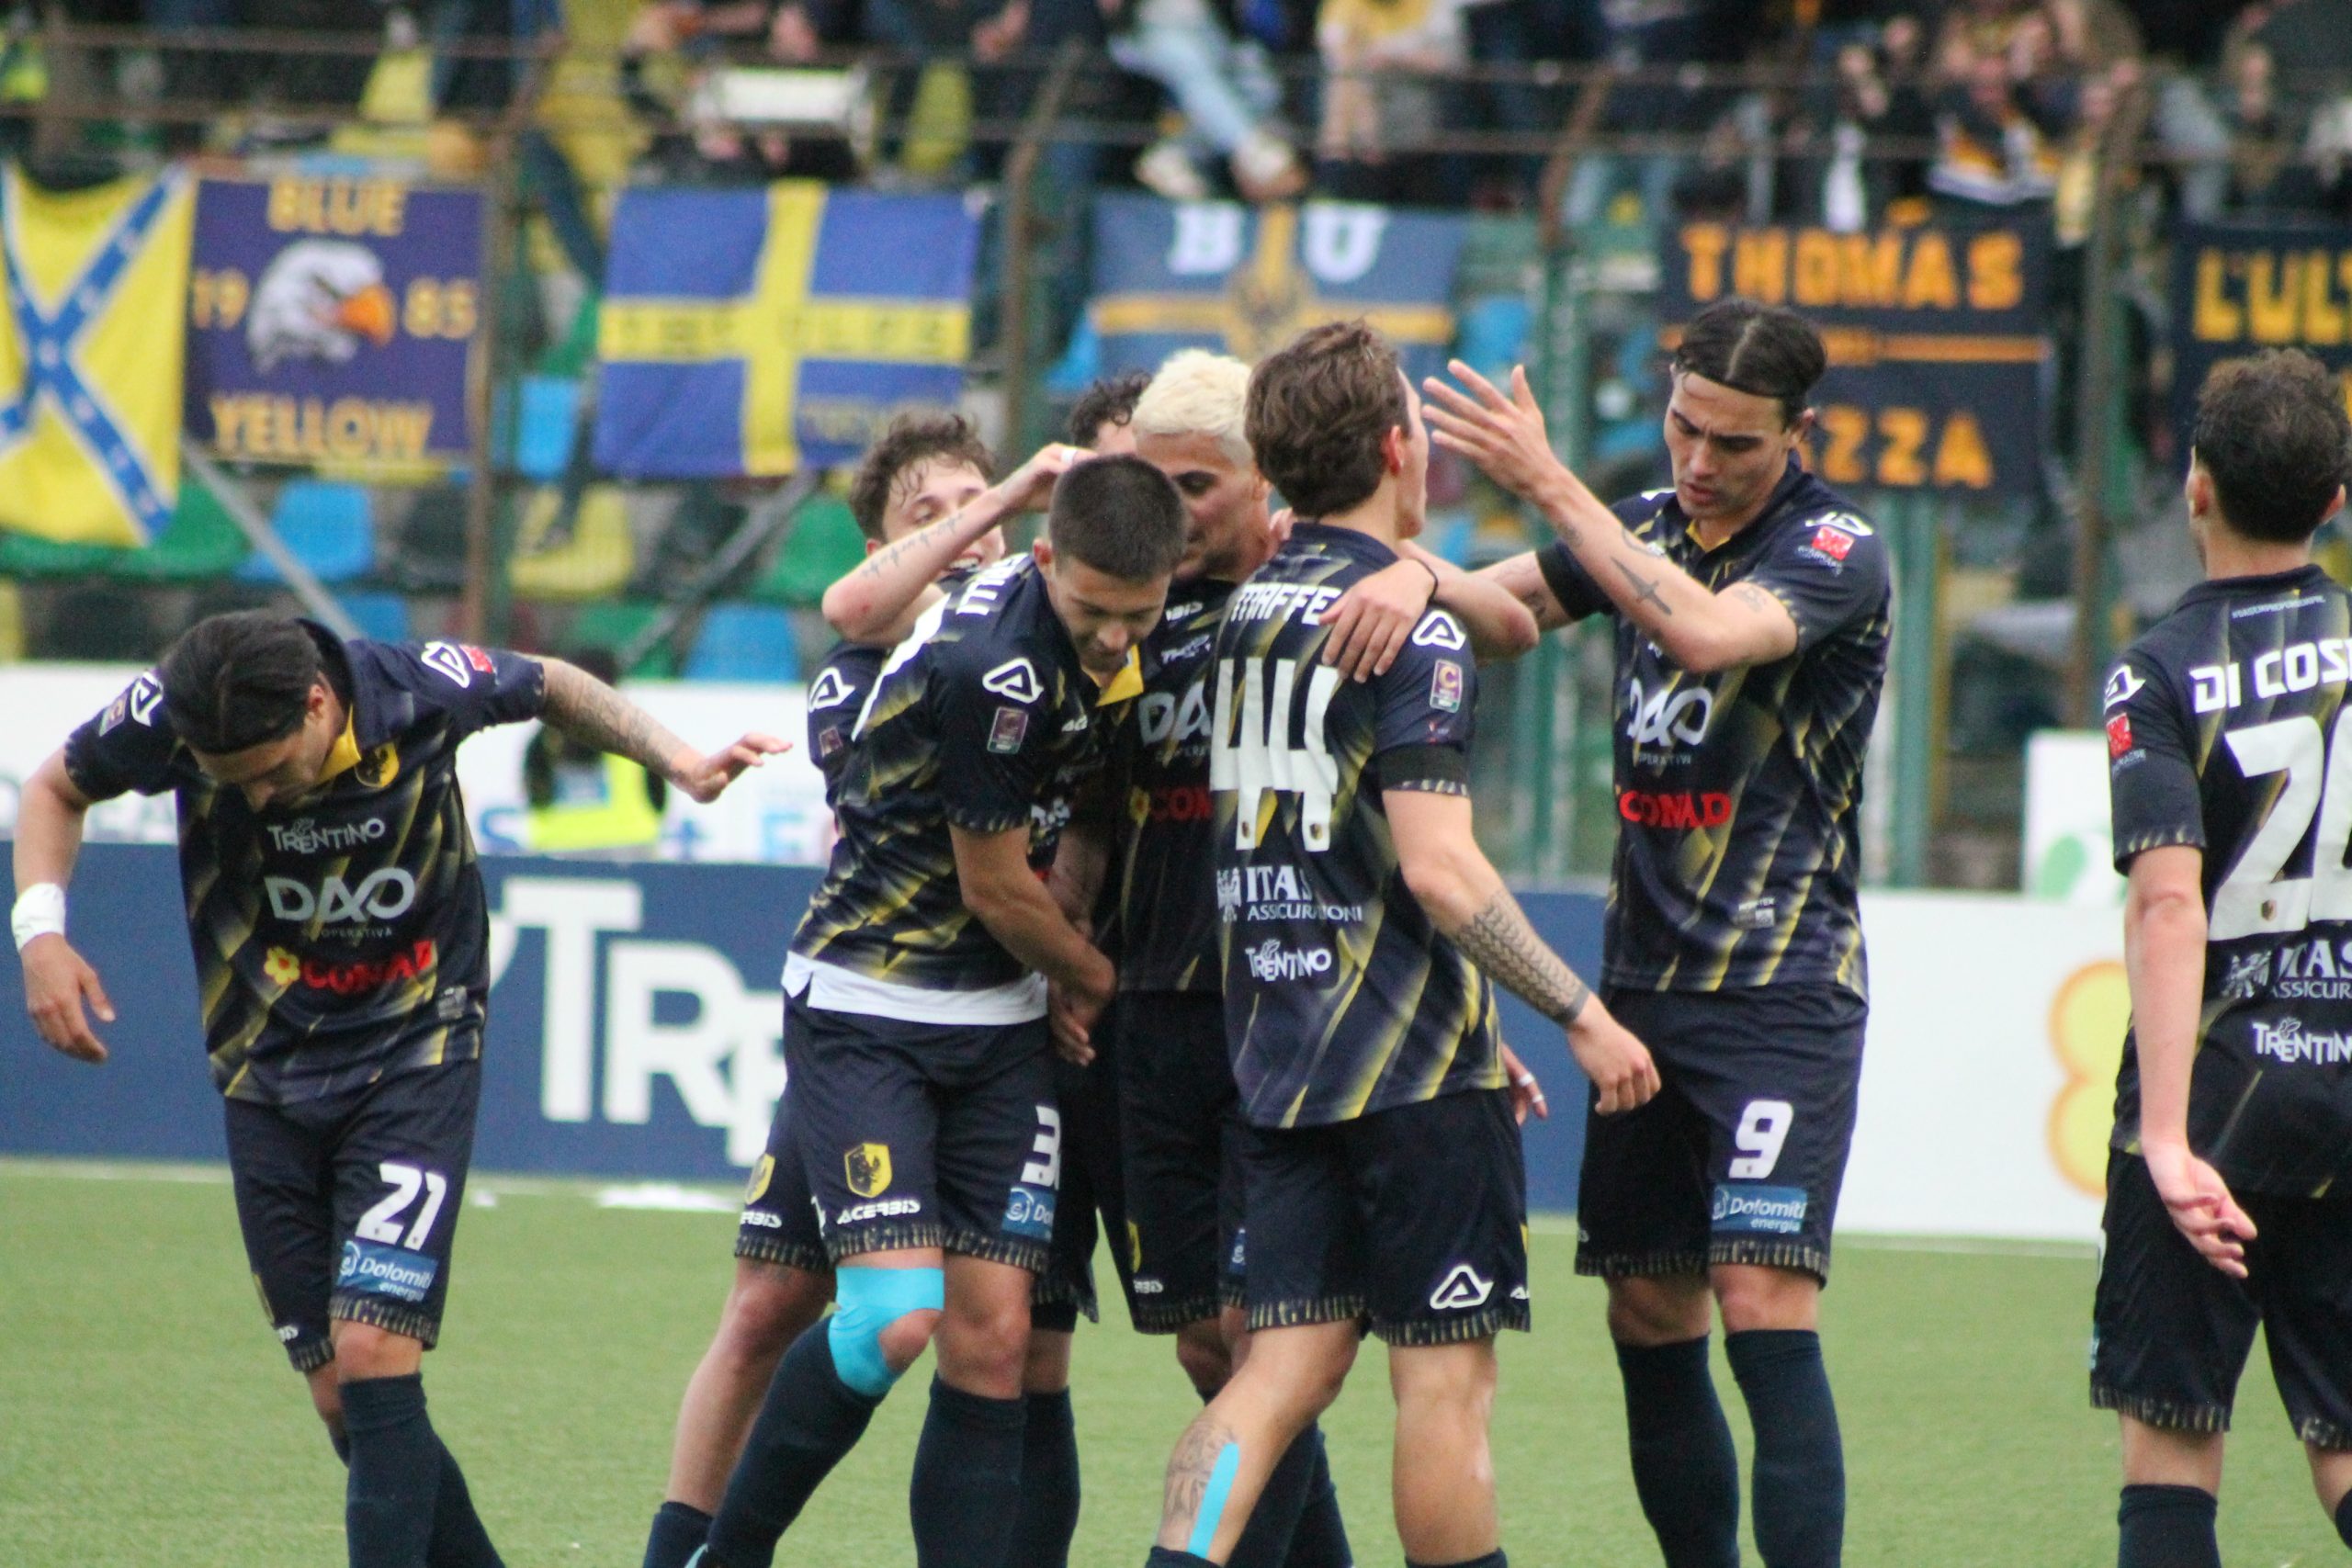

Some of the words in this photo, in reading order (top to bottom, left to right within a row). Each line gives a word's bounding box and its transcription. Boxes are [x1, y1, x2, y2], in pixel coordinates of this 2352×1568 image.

[266, 176, 407, 236] BLUE
[1166, 201, 1246, 275] B
[1301, 199, 1389, 280] U
[193, 267, 249, 330] 19
[210, 393, 435, 459] YELLOW
[1798, 404, 1996, 491] ZZA
[2189, 662, 2242, 714] DI
[1209, 658, 1340, 852] 44
[266, 818, 385, 855] TRENTINO
[1618, 789, 1733, 828] CONAD
[264, 866, 417, 923] DAO
[1245, 943, 1332, 981] TRENTINO
[1020, 1105, 1061, 1188] 3
[1728, 1099, 1794, 1179] 9
[355, 1162, 447, 1251] 21
[836, 1200, 922, 1225] ACERBIS
[1729, 1197, 1807, 1220] Dolomiti
[1750, 1218, 1802, 1234] energia
